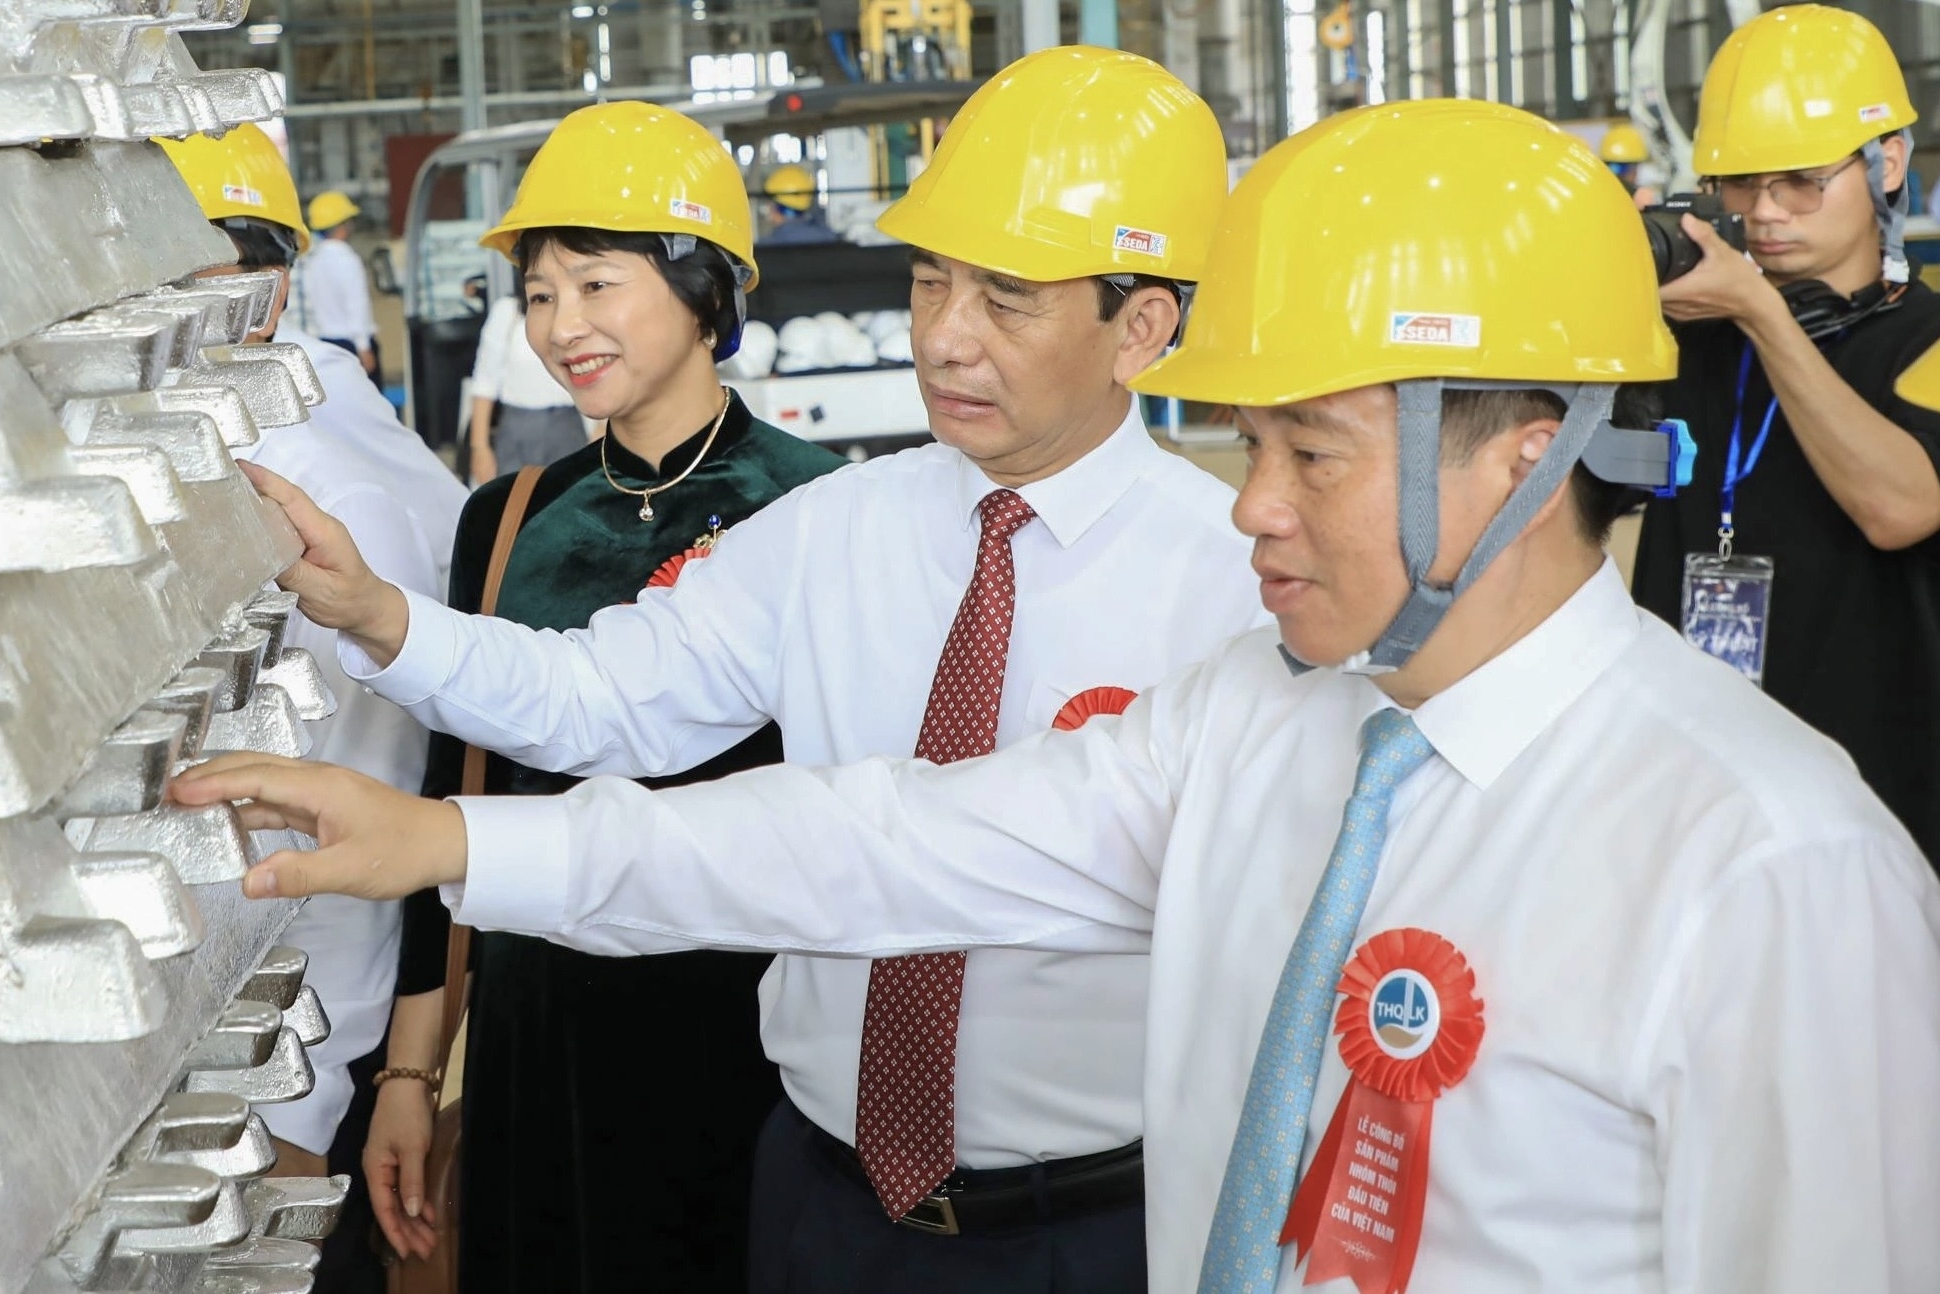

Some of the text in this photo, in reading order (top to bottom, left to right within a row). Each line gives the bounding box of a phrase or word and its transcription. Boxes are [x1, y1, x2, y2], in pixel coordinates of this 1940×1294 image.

[1369, 1121, 1393, 1145] CÔNG
[1355, 1138, 1375, 1160] SẢN
[1349, 1161, 1376, 1186] NHÔM
[1369, 1193, 1389, 1216] TIÊN
[1331, 1201, 1395, 1243] CỦA VIỆT NAM
